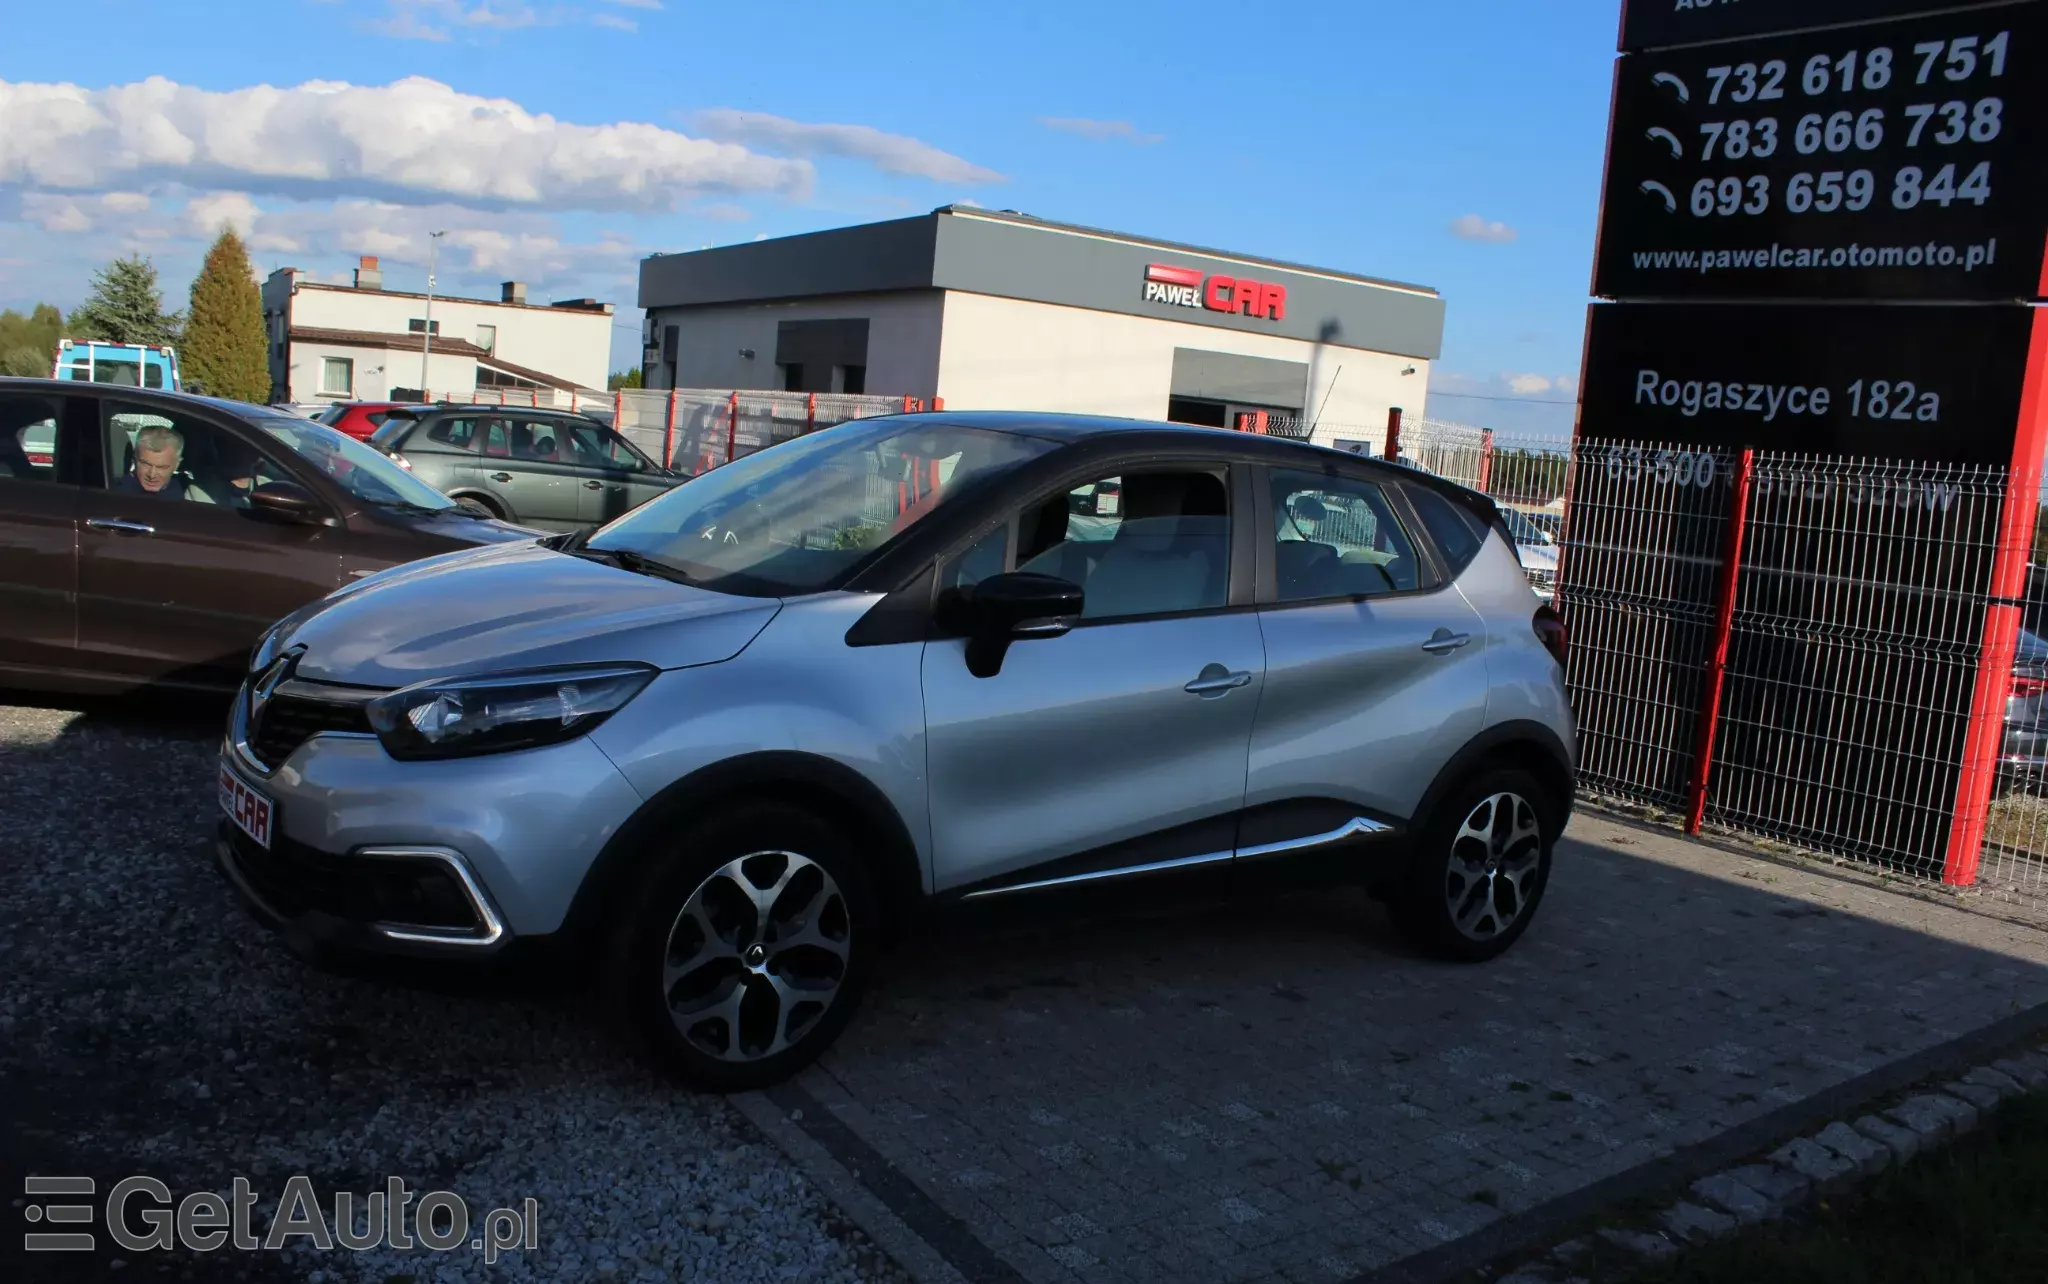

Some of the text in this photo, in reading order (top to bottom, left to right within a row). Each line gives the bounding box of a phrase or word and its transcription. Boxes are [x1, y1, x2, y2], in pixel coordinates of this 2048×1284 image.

[1706, 31, 2009, 104] 732 618 751
[1700, 98, 2003, 161] 783 666 738
[1690, 161, 1991, 217] 693 659 844
[1633, 238, 1996, 273] www.pawelcar.otomoto.pl
[1145, 273, 1287, 320] PAWEŁ CAR
[1635, 370, 1940, 422] Rogaszyce 182a
[235, 782, 269, 845] CAR
